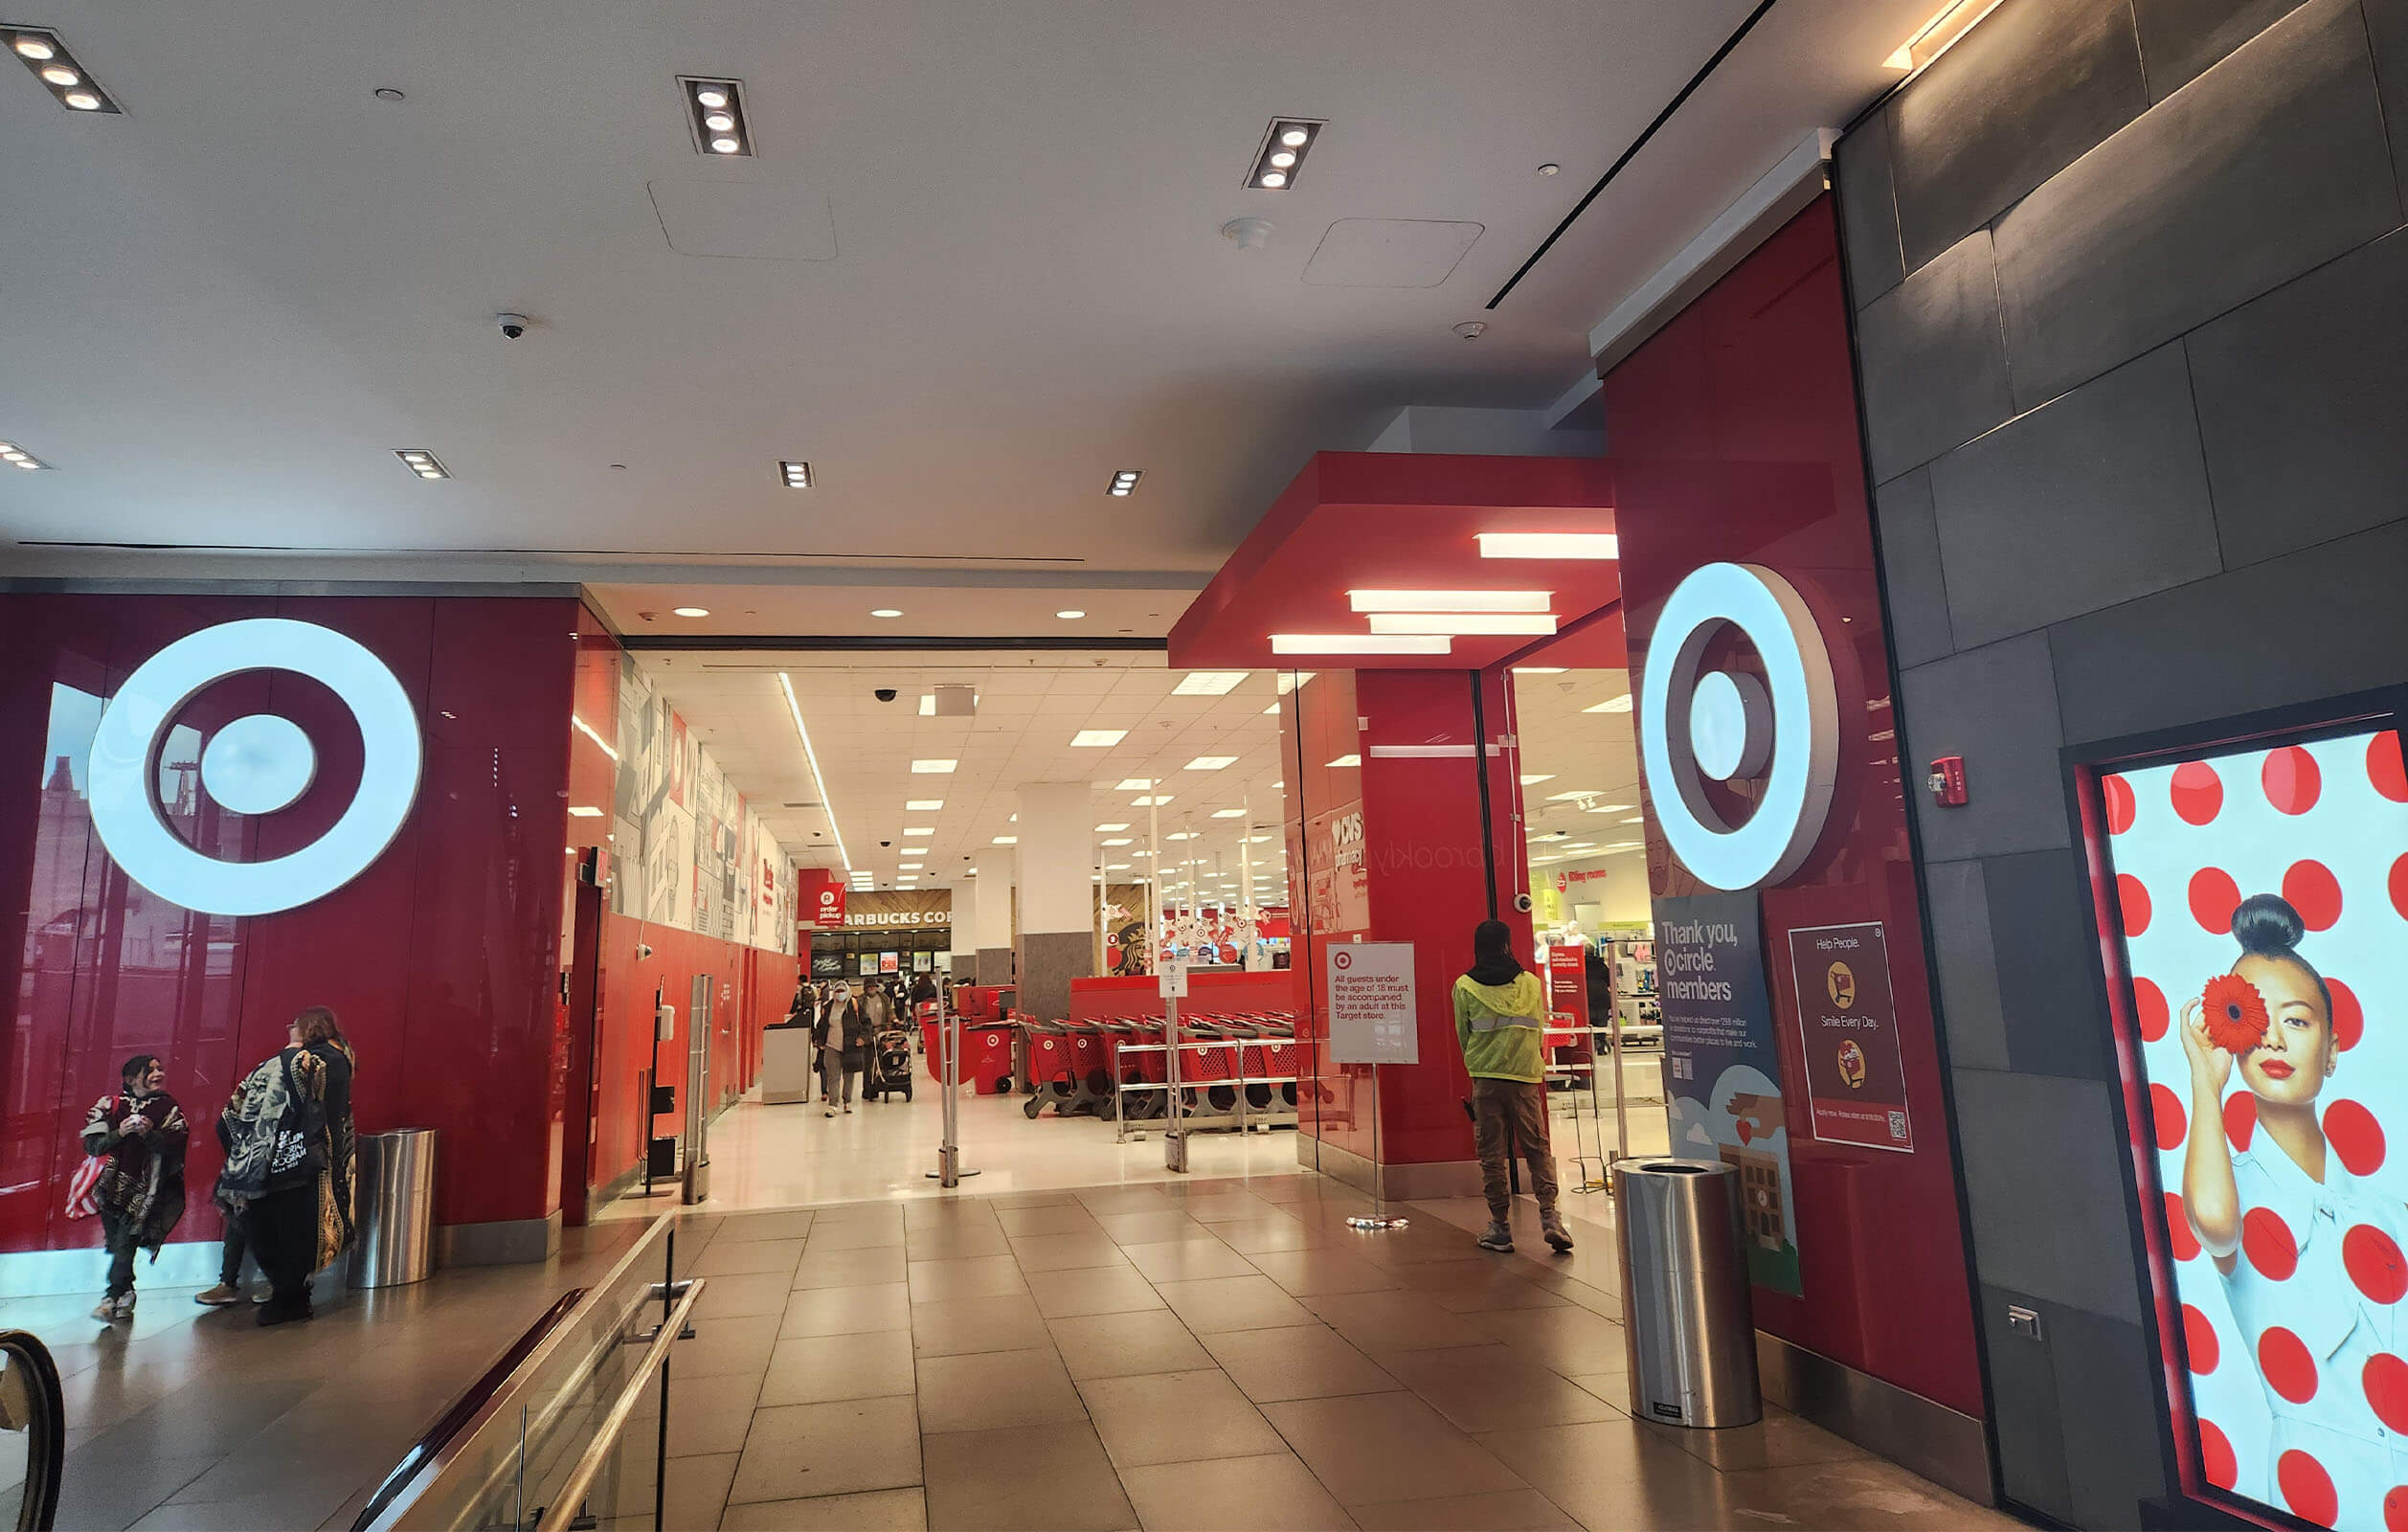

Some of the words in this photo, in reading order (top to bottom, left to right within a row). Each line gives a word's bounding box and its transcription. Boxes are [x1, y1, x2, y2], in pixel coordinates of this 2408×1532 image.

[1341, 812, 1362, 844] CVS
[844, 912, 920, 926] ARBUCKS
[924, 911, 952, 923] COF
[1662, 919, 1704, 944] Thank
[1706, 923, 1739, 948] you,
[1816, 938, 1833, 952] Help
[1833, 937, 1860, 951] People.
[1346, 976, 1374, 984] guests
[1349, 985, 1365, 994] age
[1667, 976, 1732, 1001] members
[1347, 994, 1402, 1003] accompanied
[1336, 1003, 1345, 1012] by
[1336, 1012, 1362, 1021] Target
[1821, 1015, 1840, 1027] Smile
[1840, 1015, 1861, 1030] Every
[1861, 1016, 1879, 1030] Day.
